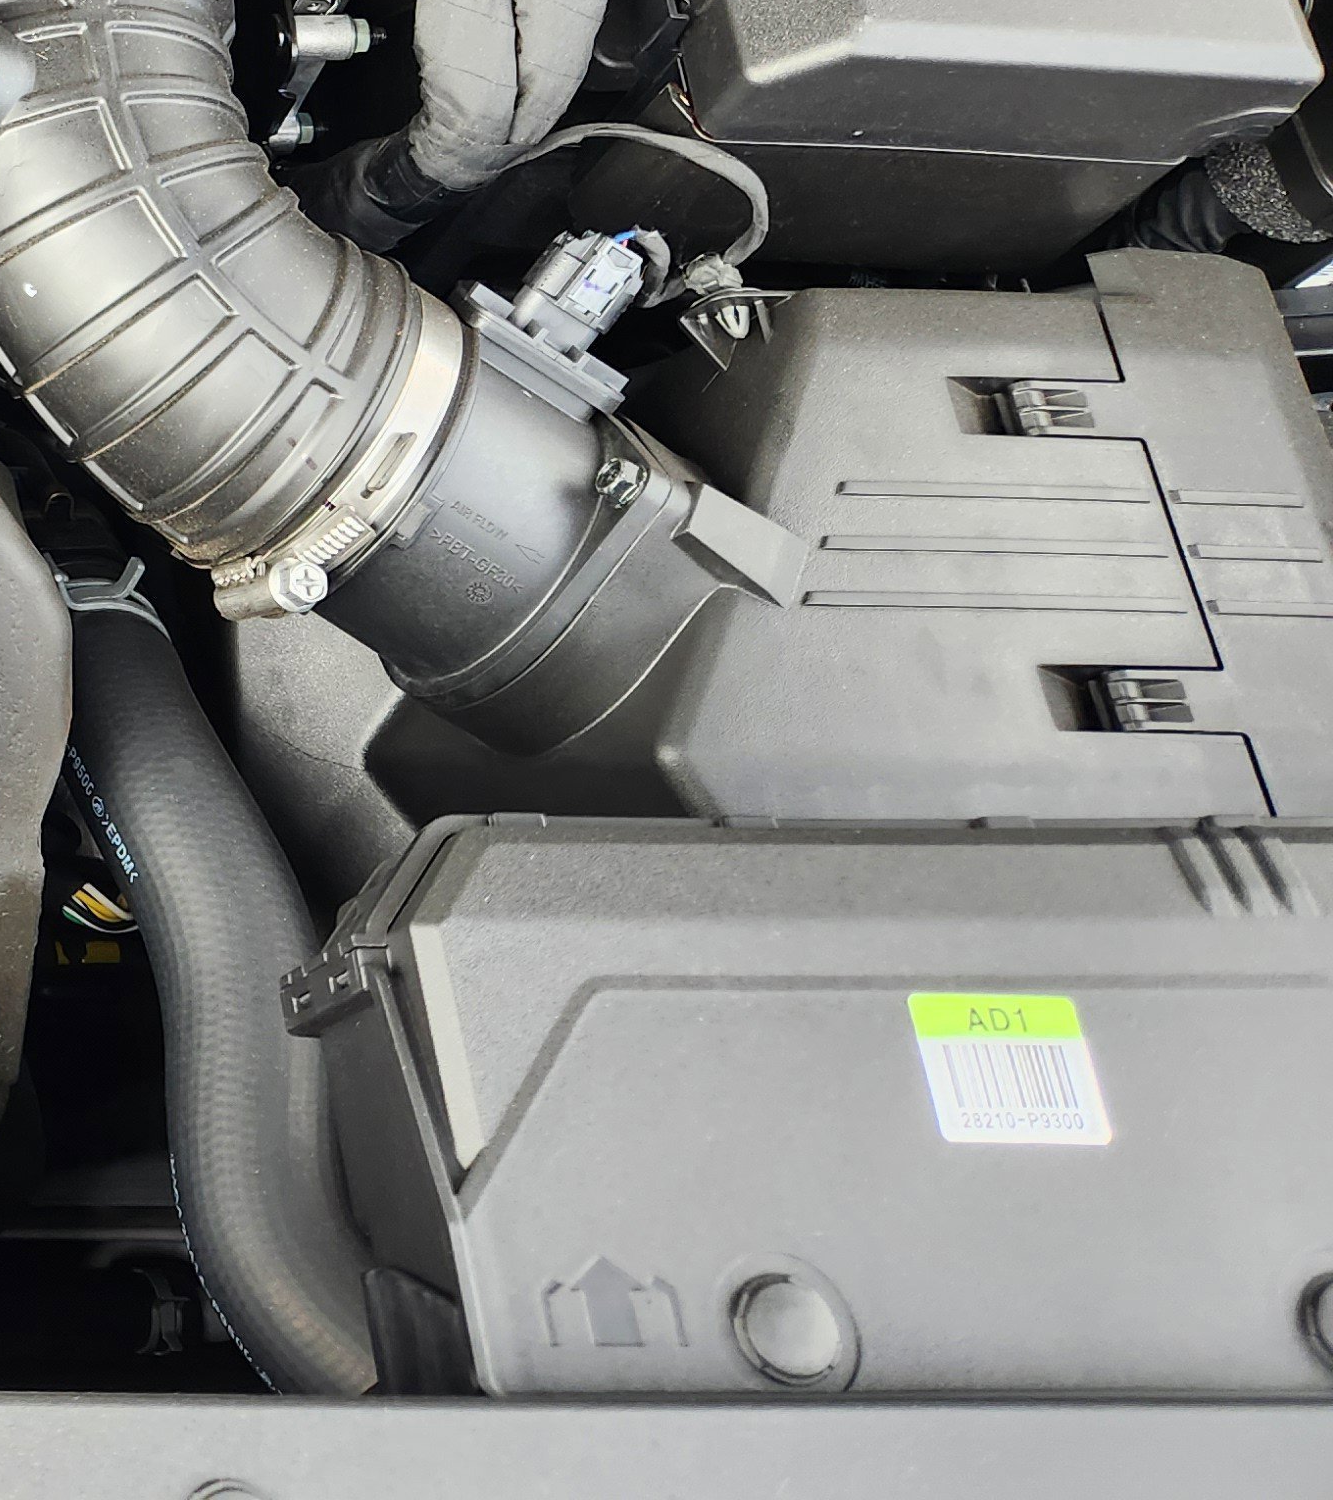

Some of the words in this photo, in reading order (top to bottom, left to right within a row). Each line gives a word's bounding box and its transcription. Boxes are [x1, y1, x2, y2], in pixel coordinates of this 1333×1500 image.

[450, 501, 473, 520] AIR
[101, 812, 139, 884] >EPDM<
[969, 1008, 1028, 1032] AD1
[961, 1112, 1084, 1129] 28210-P9300
